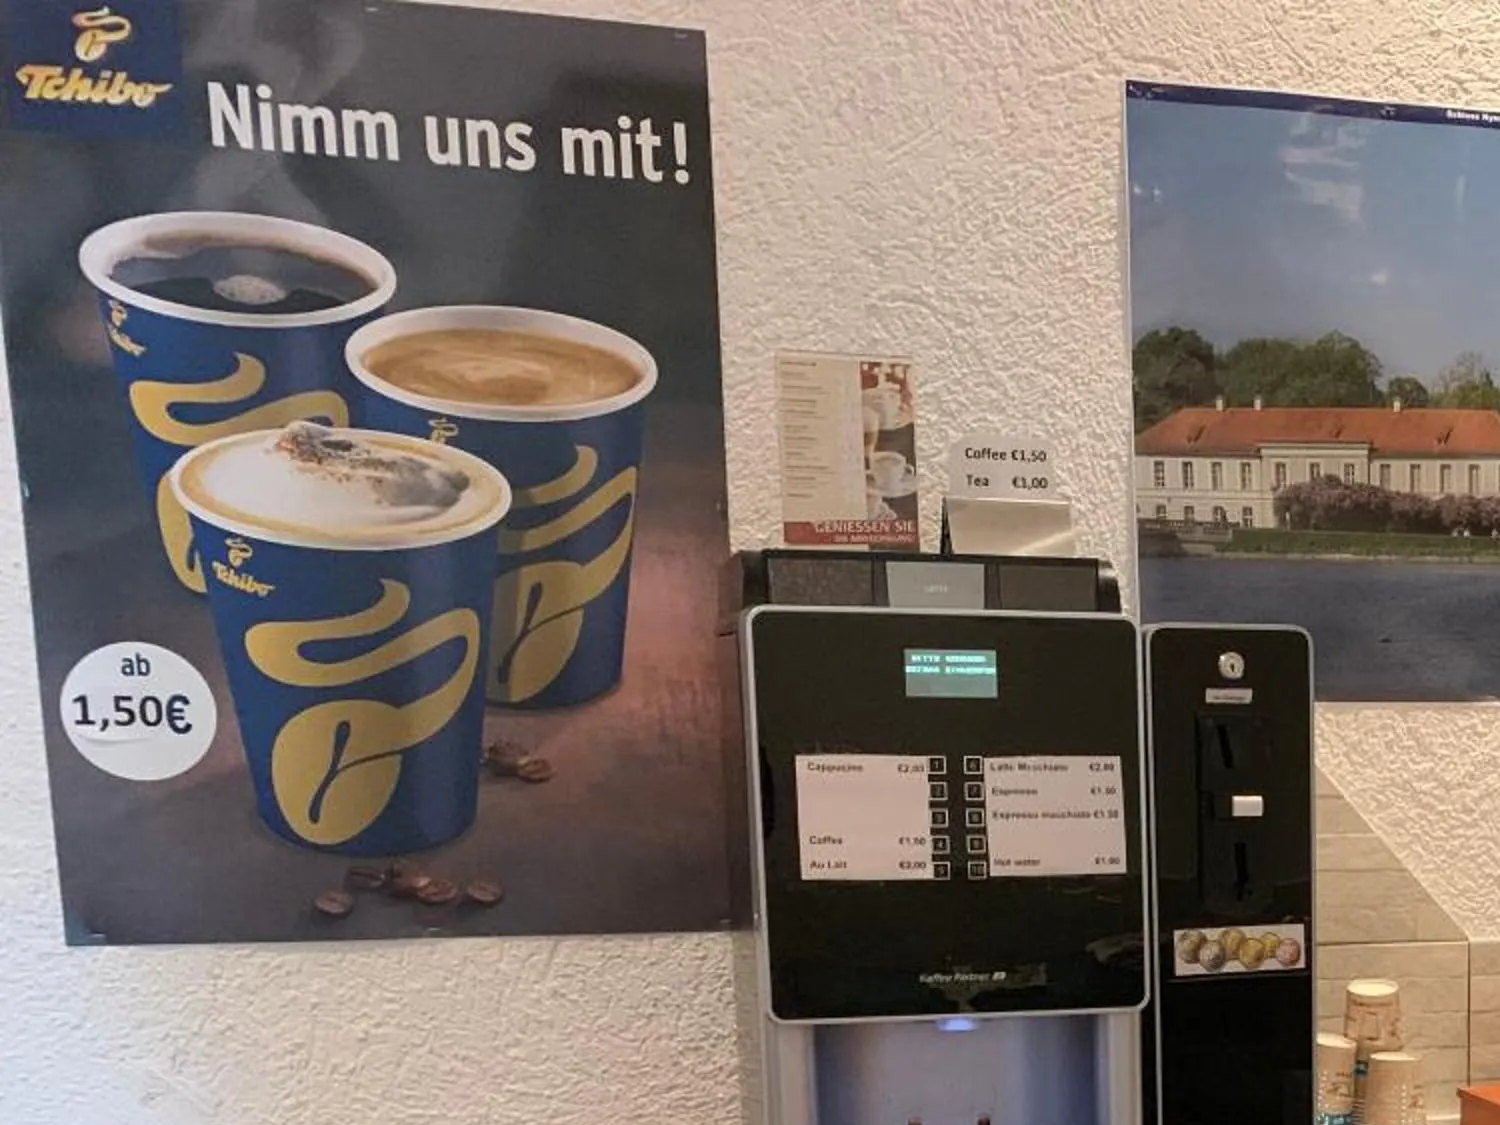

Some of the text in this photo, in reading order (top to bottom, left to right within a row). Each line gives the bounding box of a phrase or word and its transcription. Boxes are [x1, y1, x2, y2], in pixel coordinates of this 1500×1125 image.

[16, 64, 173, 108] Tchibo
[207, 81, 691, 185] Nimm uns mit!
[964, 447, 1047, 463] Coffee €1,50
[966, 474, 1049, 490] Tea €1,00
[211, 560, 276, 598] Tchibo
[121, 652, 151, 677] ab
[72, 693, 193, 735] 1,50€
[809, 835, 843, 845] Coffee
